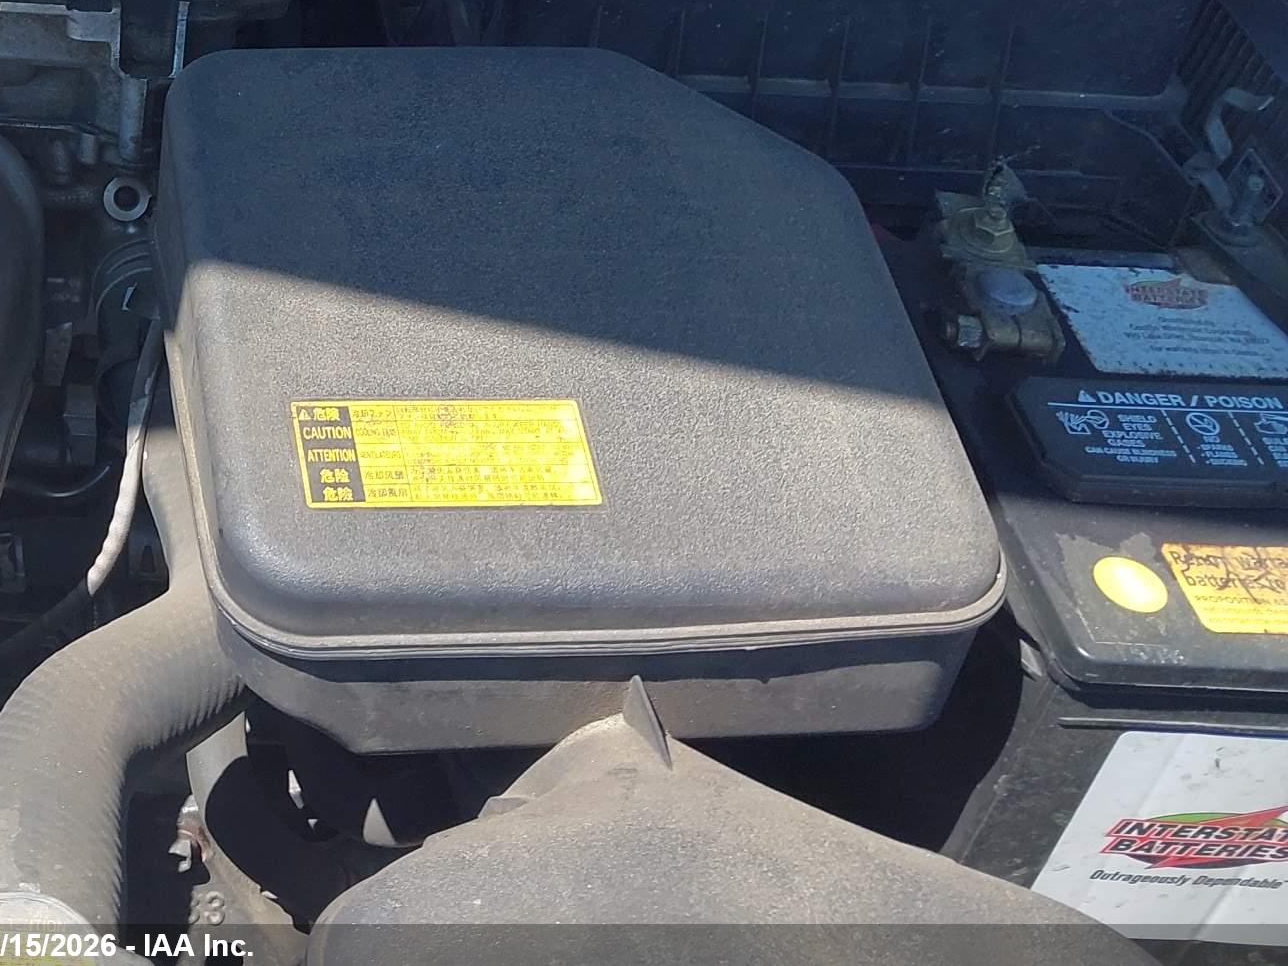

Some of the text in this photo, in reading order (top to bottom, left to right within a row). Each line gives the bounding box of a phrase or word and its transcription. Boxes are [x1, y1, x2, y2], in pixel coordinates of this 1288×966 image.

[1096, 391, 1283, 409] DANGER / POISON
[1117, 414, 1158, 423] SHIELD
[303, 426, 353, 440] CAUTION
[1122, 422, 1153, 431] EYES
[1102, 430, 1164, 440] EXPLOSIVE
[1107, 438, 1146, 448] GASES
[307, 448, 356, 463] ATTENTION
[1109, 838, 1288, 859] BATTERIES
[1089, 869, 1282, 890] Outrageously Dependable
